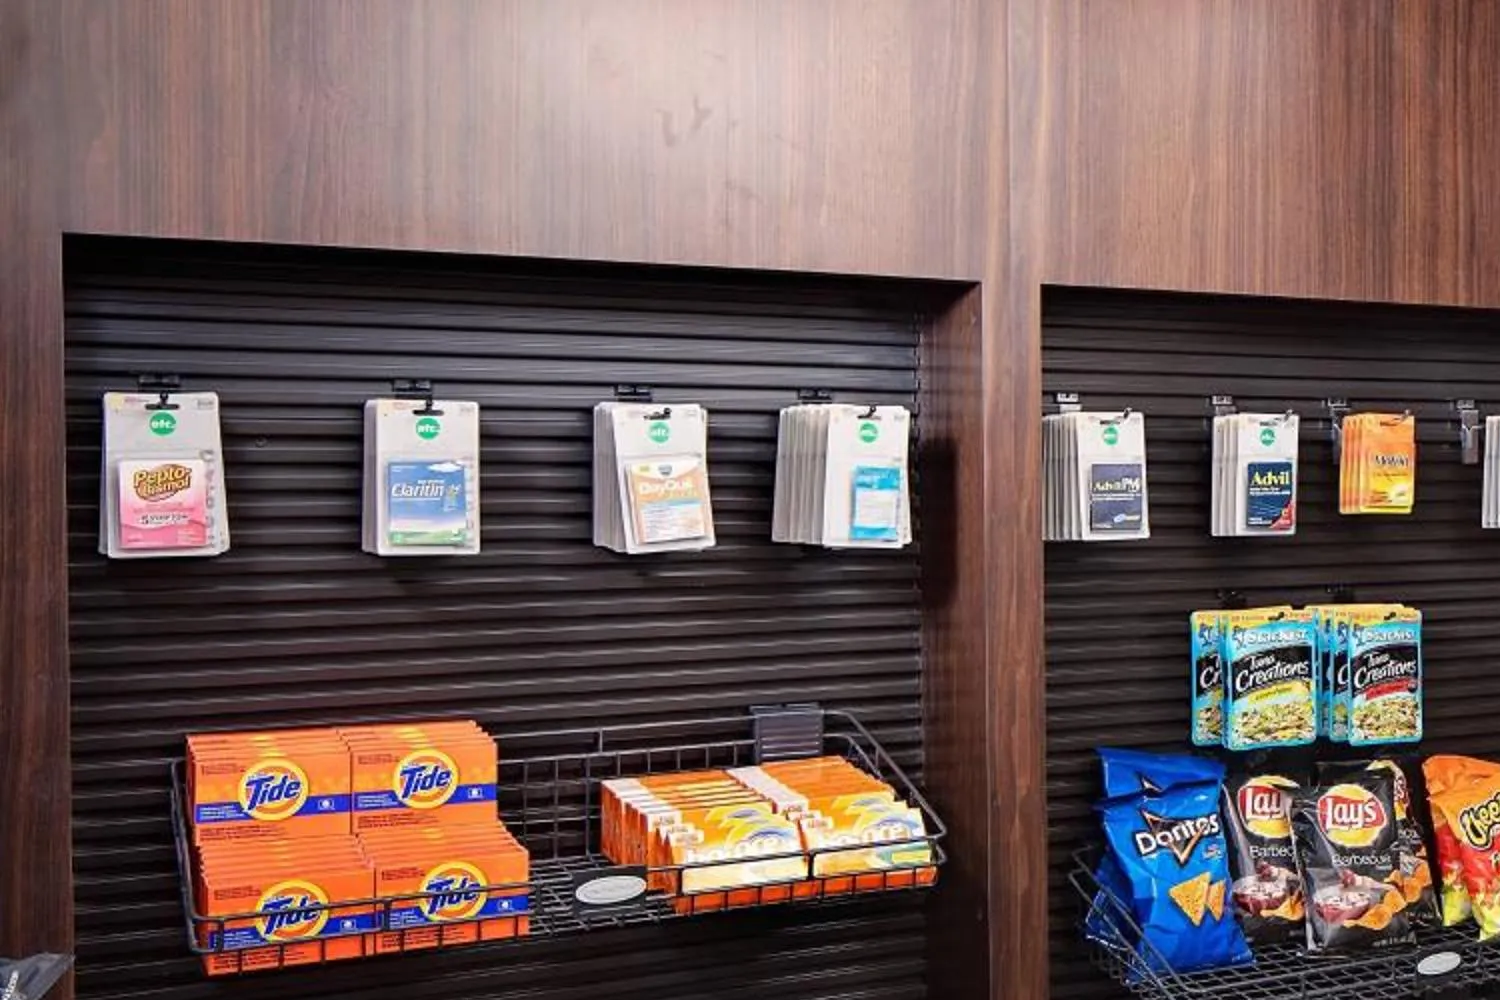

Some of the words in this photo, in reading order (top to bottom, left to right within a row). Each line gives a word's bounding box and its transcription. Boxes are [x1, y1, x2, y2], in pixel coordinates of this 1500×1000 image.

[391, 482, 445, 498] Claritin
[1251, 471, 1290, 485] Advil
[1235, 661, 1309, 692] Creations
[1353, 660, 1417, 689] Creations
[244, 774, 301, 812] Tide
[399, 764, 451, 799] Tide
[1327, 796, 1378, 829] Lay's
[1134, 813, 1220, 855] Doritos
[425, 876, 482, 915] Tide
[261, 896, 321, 936] Tide
